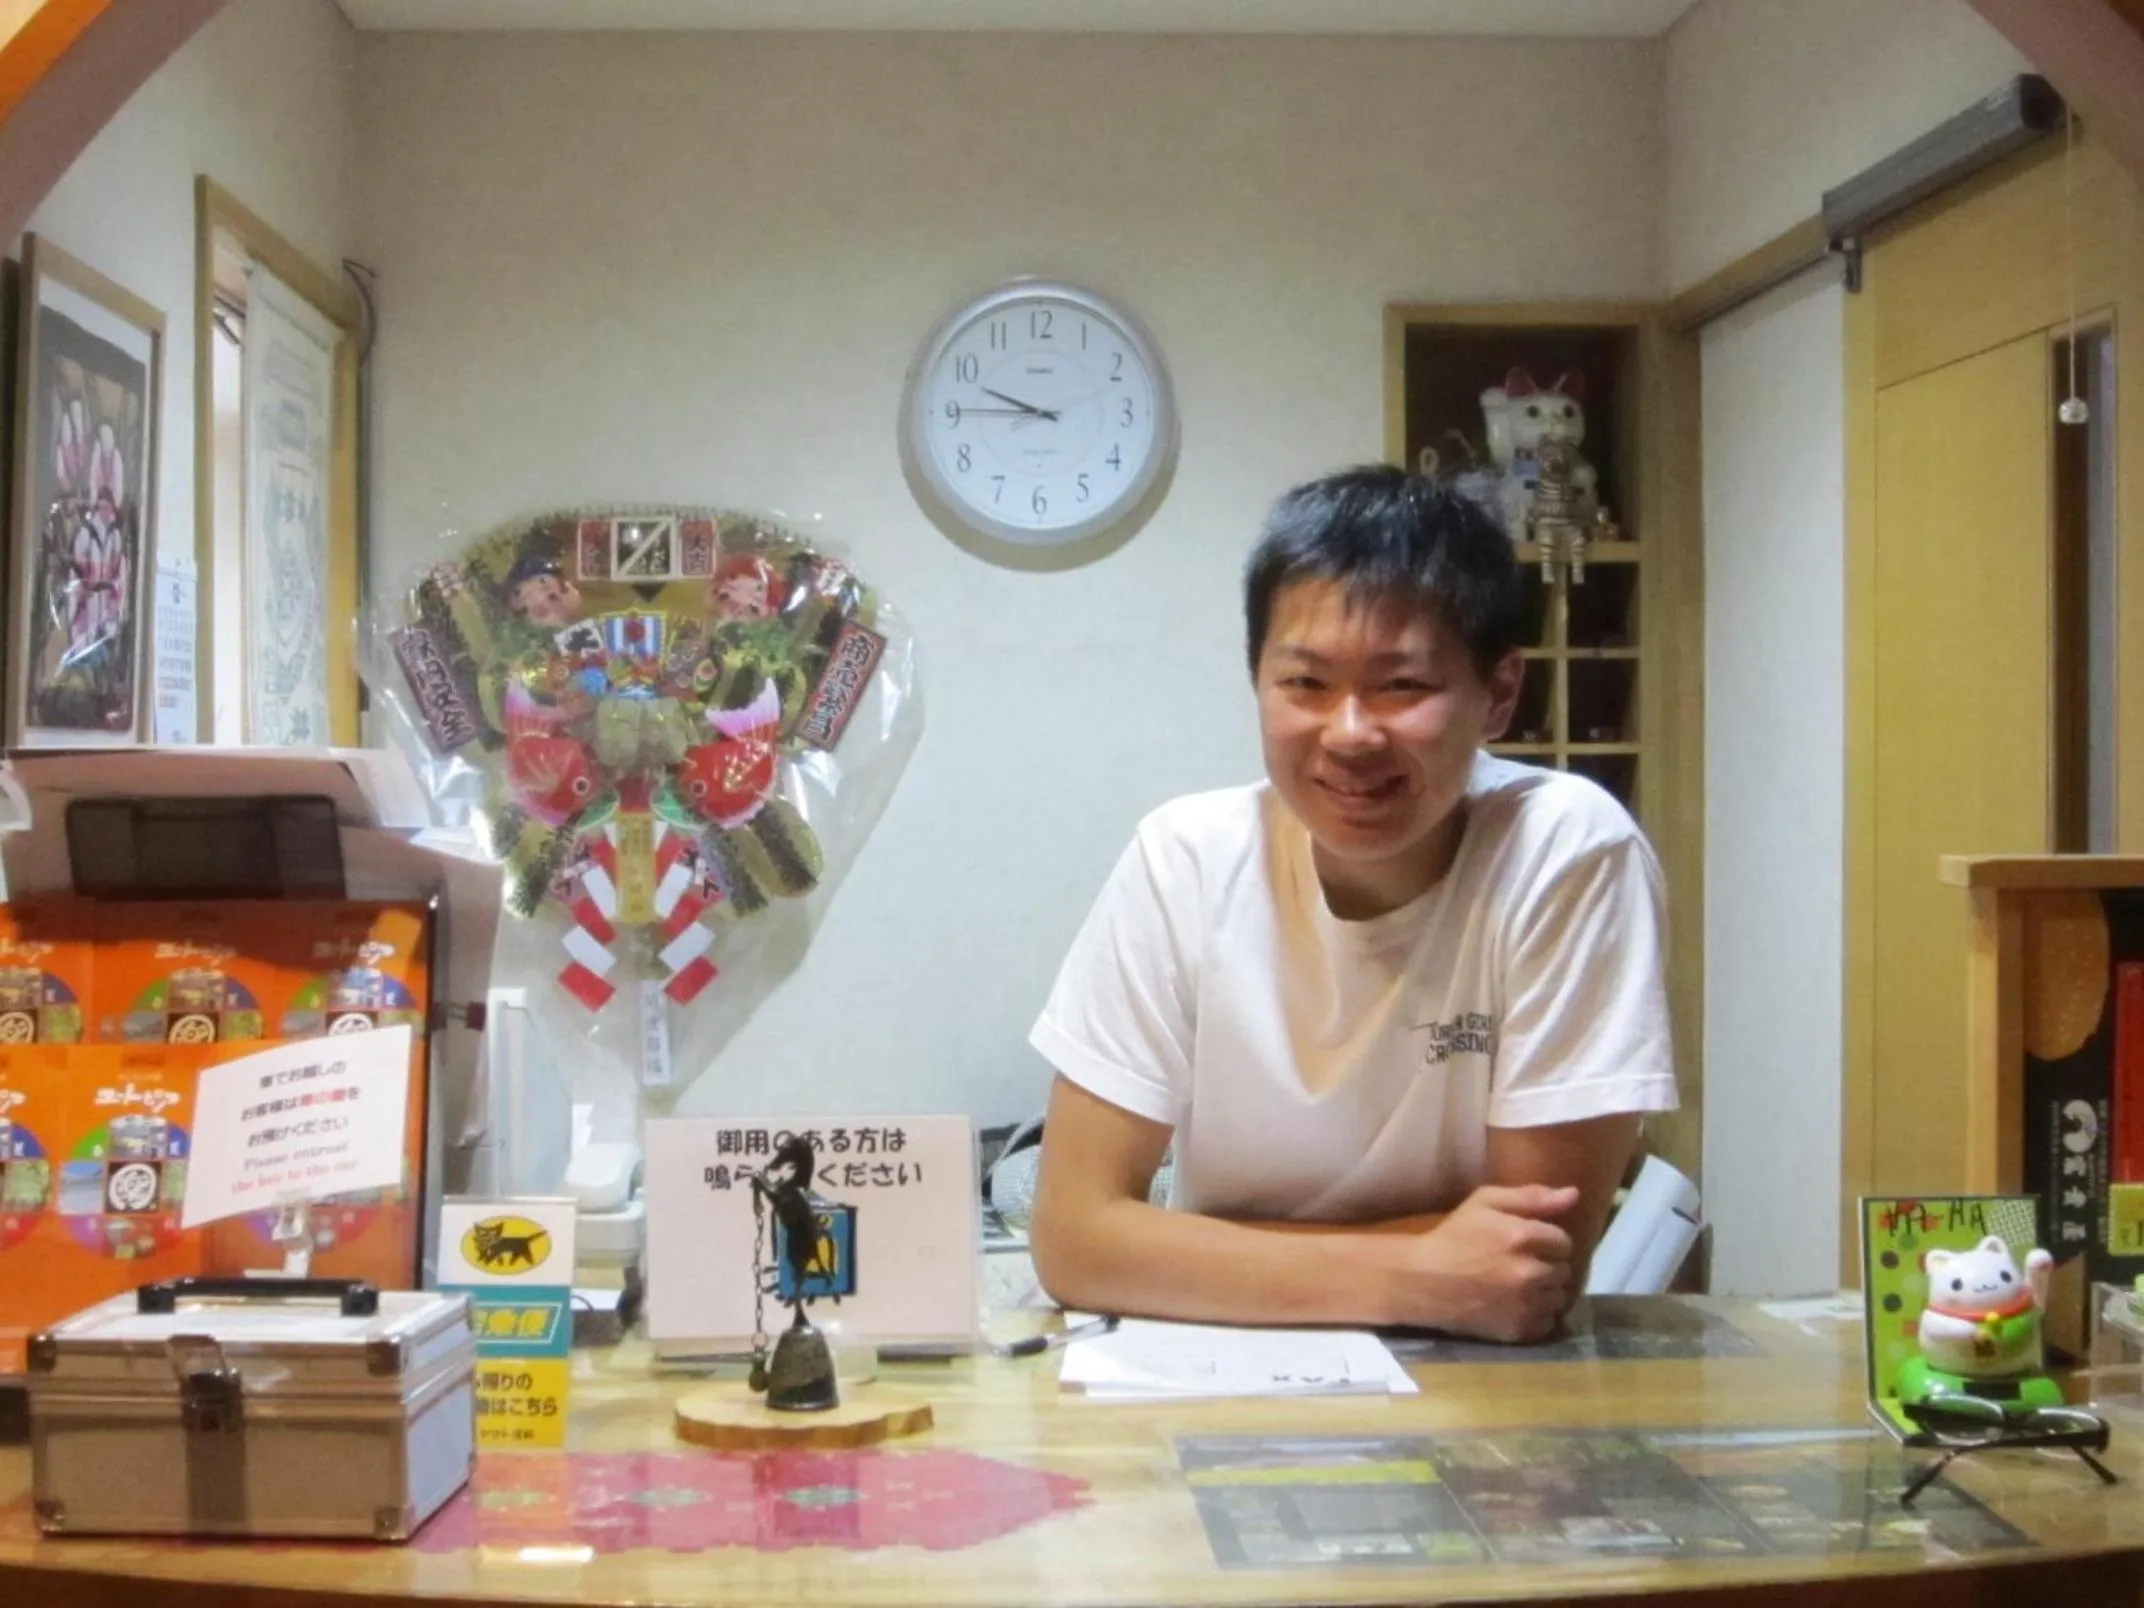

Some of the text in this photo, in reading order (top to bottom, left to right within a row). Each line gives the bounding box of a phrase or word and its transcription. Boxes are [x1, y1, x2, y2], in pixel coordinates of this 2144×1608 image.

[990, 322, 1007, 350] 11
[1030, 310, 1053, 340] 12
[955, 353, 979, 384] 10
[1109, 352, 1123, 382] 2
[945, 400, 961, 429] 9
[1119, 397, 1134, 428] 3
[956, 443, 972, 472] 8
[1105, 443, 1121, 472] 4
[990, 474, 1005, 503] 7
[1031, 485, 1047, 515] 6
[1077, 473, 1090, 502] 5
[703, 1162, 923, 1190] 鳴らください
